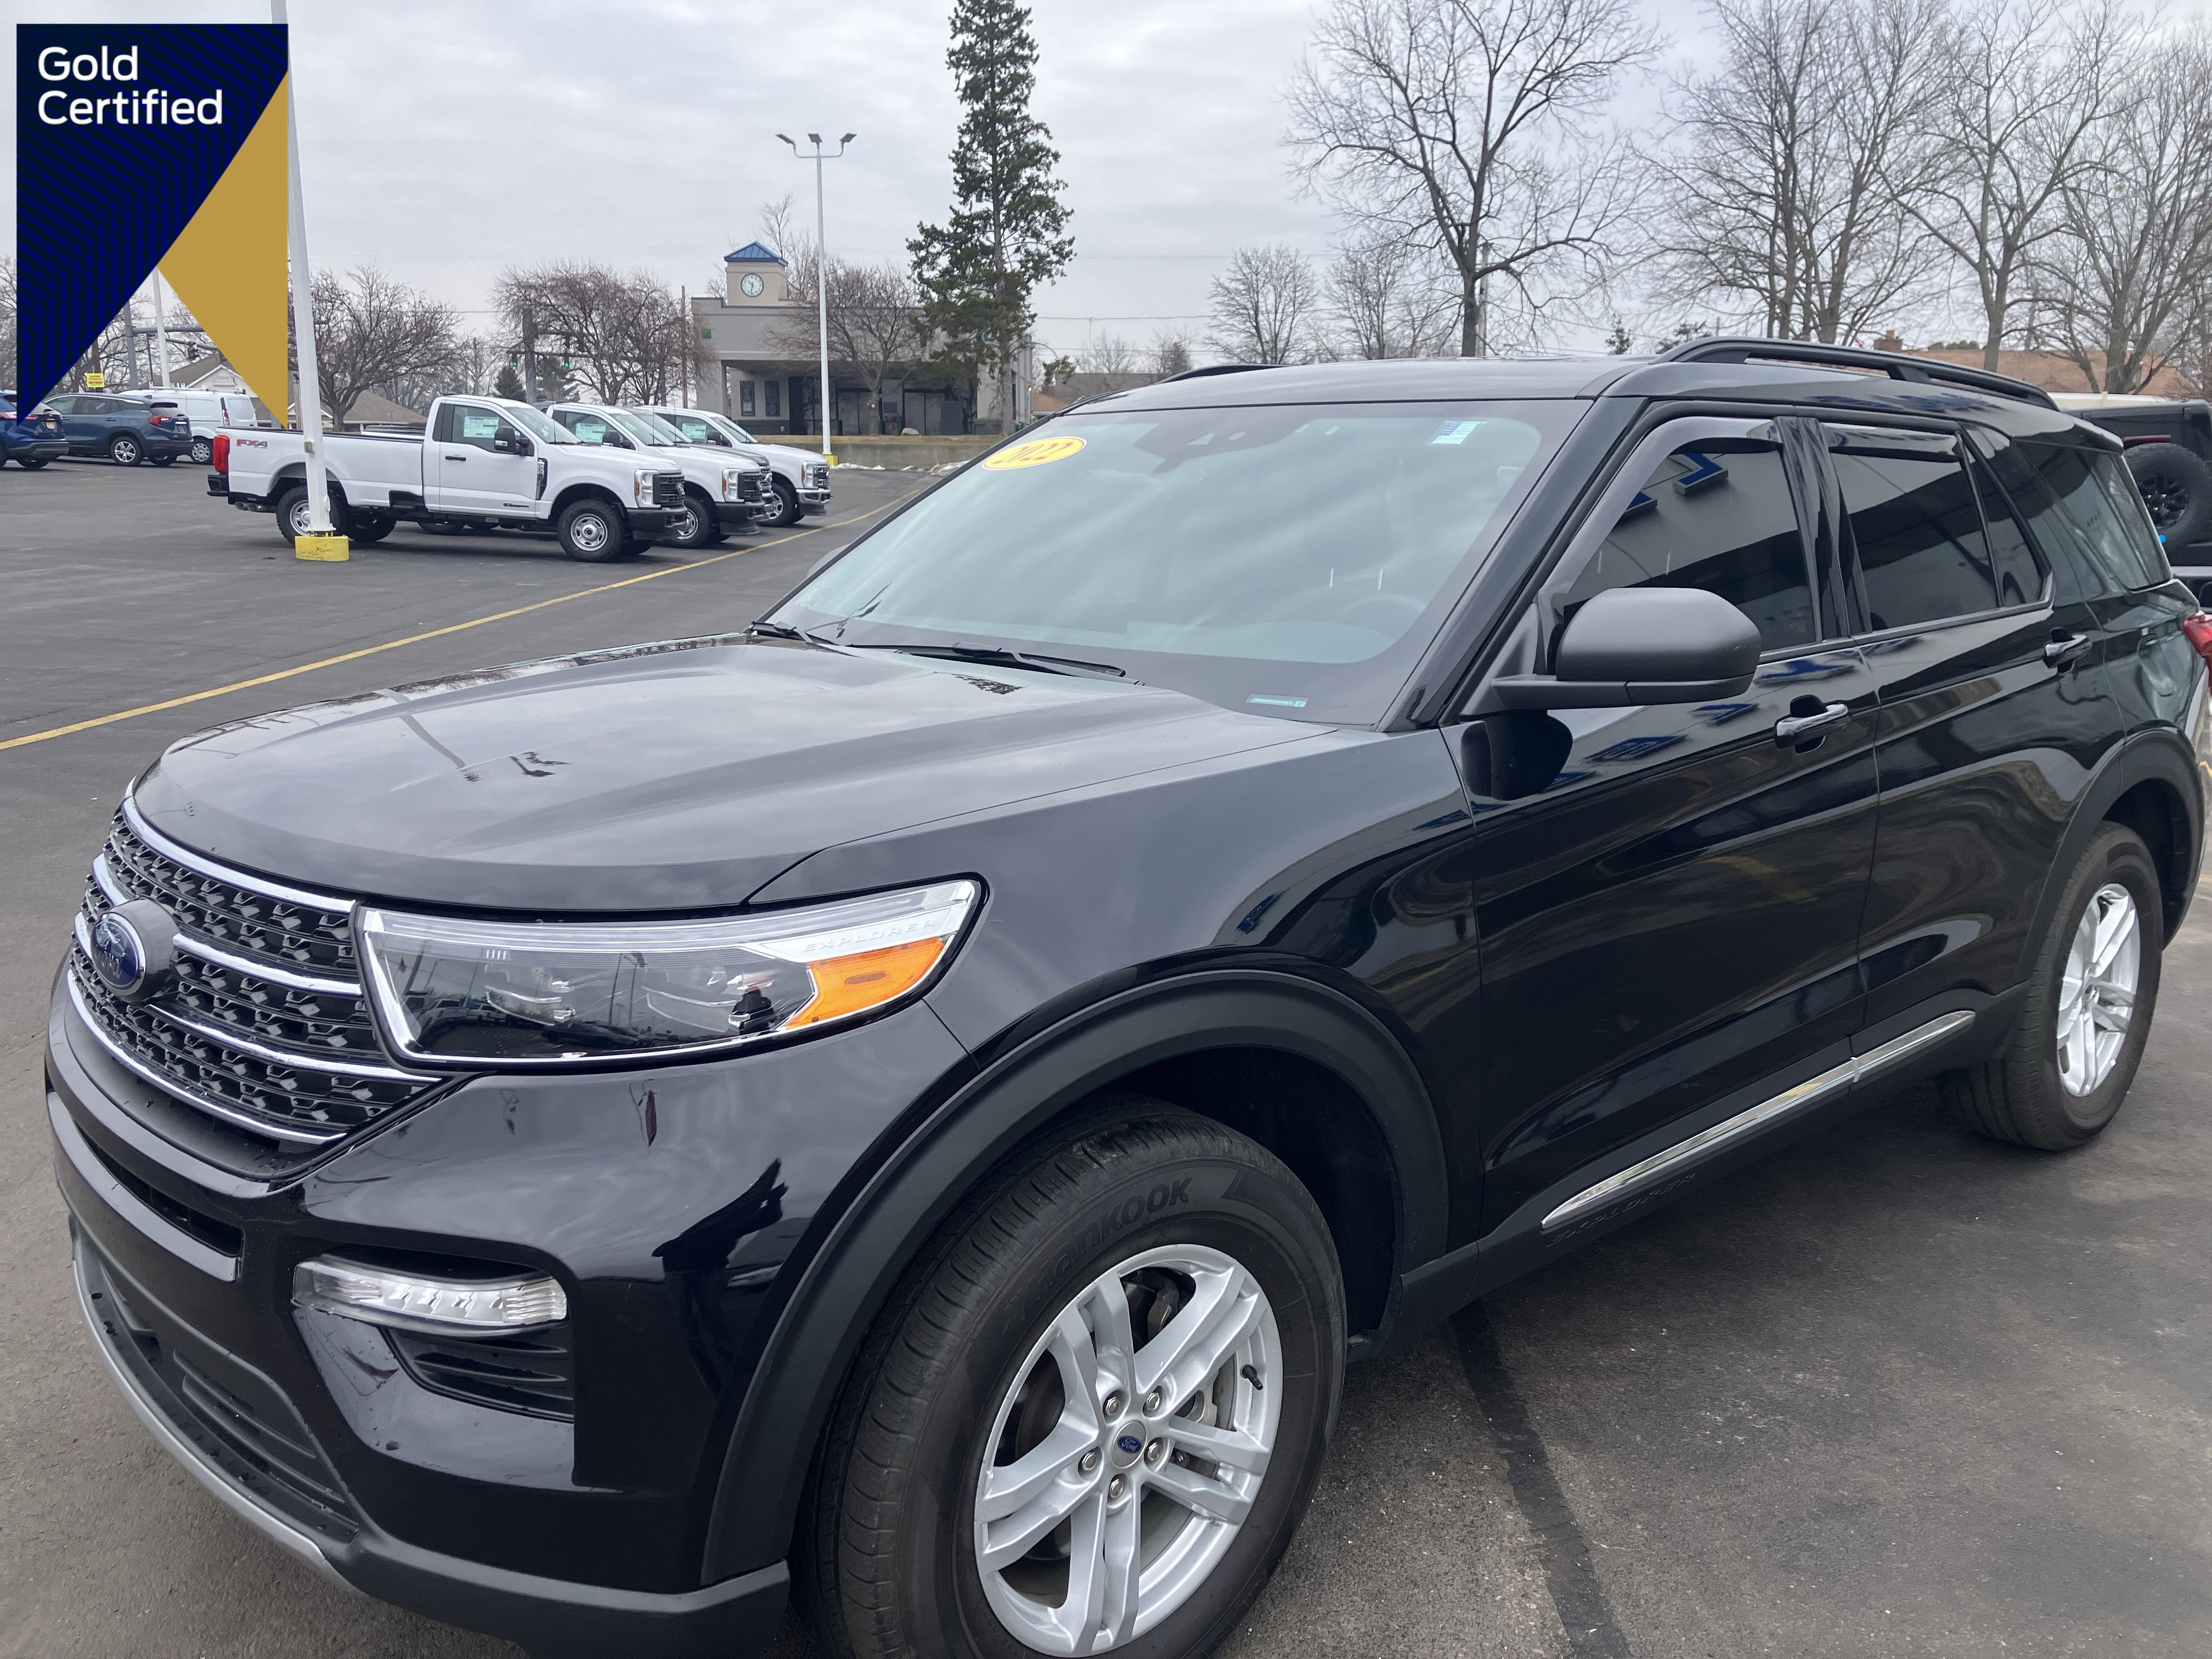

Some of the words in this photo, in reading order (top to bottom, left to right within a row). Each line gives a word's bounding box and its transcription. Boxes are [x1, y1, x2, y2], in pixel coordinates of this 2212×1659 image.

[236, 438, 268, 448] FX4
[991, 442, 1074, 465] 2022
[802, 919, 936, 952] EXPLORER
[1121, 1437, 1139, 1451] Ford
